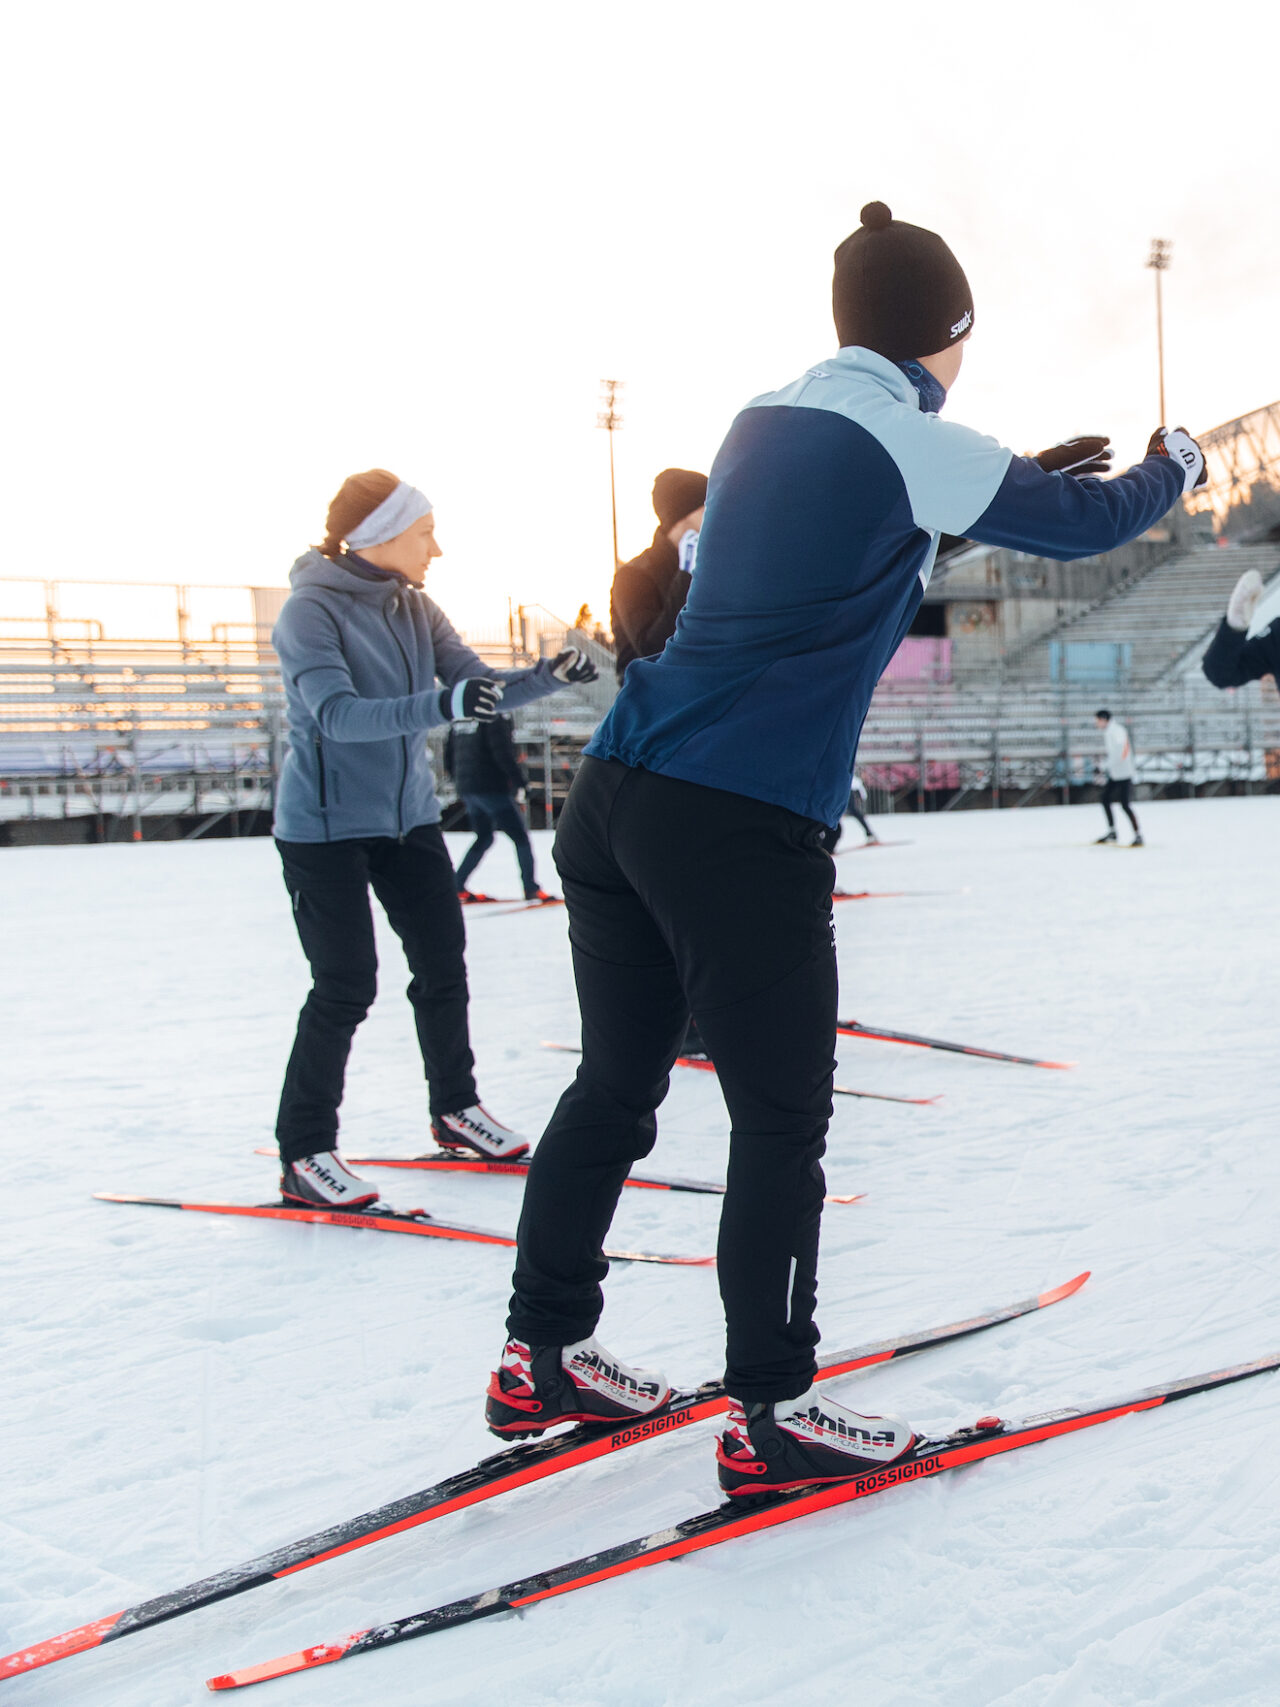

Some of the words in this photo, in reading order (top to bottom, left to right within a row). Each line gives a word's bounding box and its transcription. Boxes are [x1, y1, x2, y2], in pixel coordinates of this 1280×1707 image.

[950, 310, 972, 338] swix
[455, 1109, 504, 1148] lpina
[303, 1156, 347, 1196] lpina
[611, 1409, 694, 1448] ROSSIGNOL
[855, 1456, 945, 1494] ROSSIGNOL
